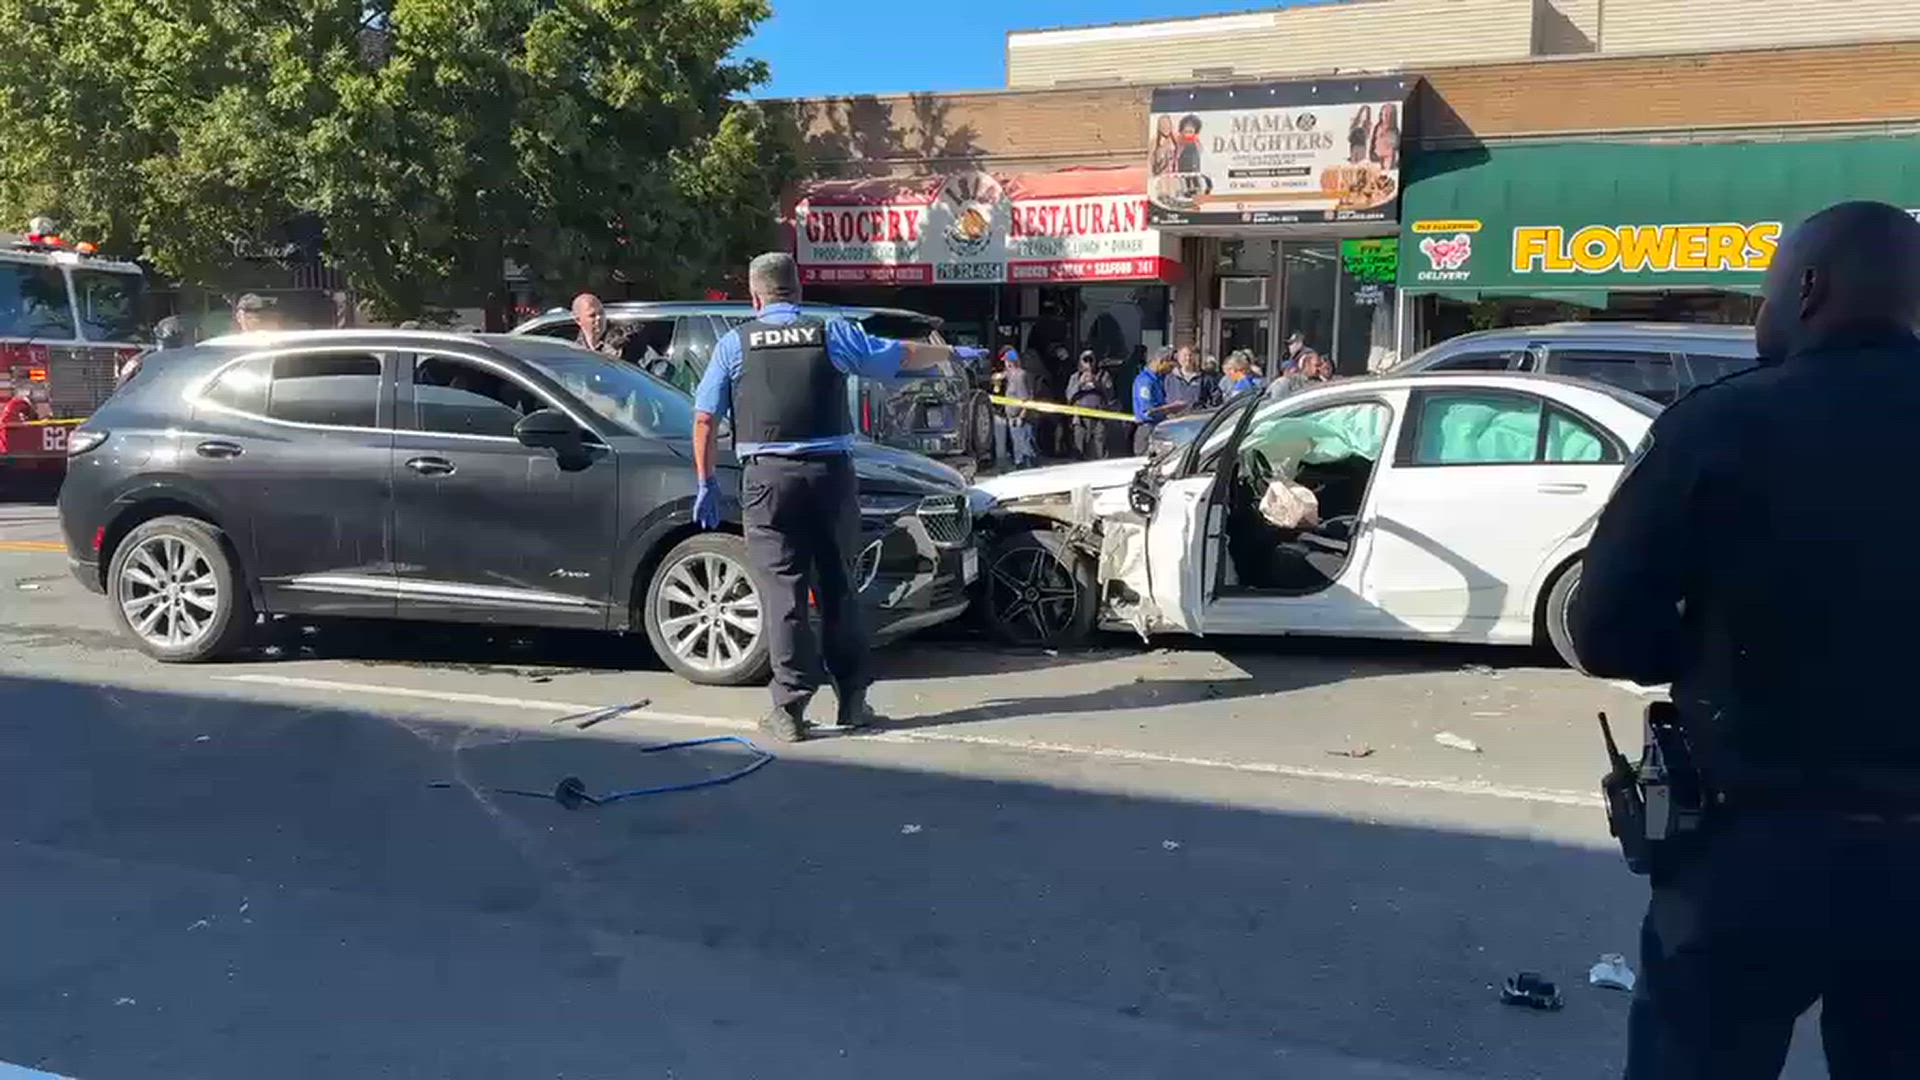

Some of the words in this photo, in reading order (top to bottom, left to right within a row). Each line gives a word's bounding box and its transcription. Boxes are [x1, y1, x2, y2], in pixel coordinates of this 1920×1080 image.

[1231, 113, 1295, 134] MAMA
[1213, 131, 1334, 154] DAUGHTERS
[806, 209, 920, 243] GROCERY
[1010, 199, 1149, 240] RESTAURANT
[1513, 222, 1783, 273] FLOWERS
[1418, 271, 1470, 281] DELIVERY
[751, 327, 816, 347] FDNY
[43, 426, 67, 451] 62
